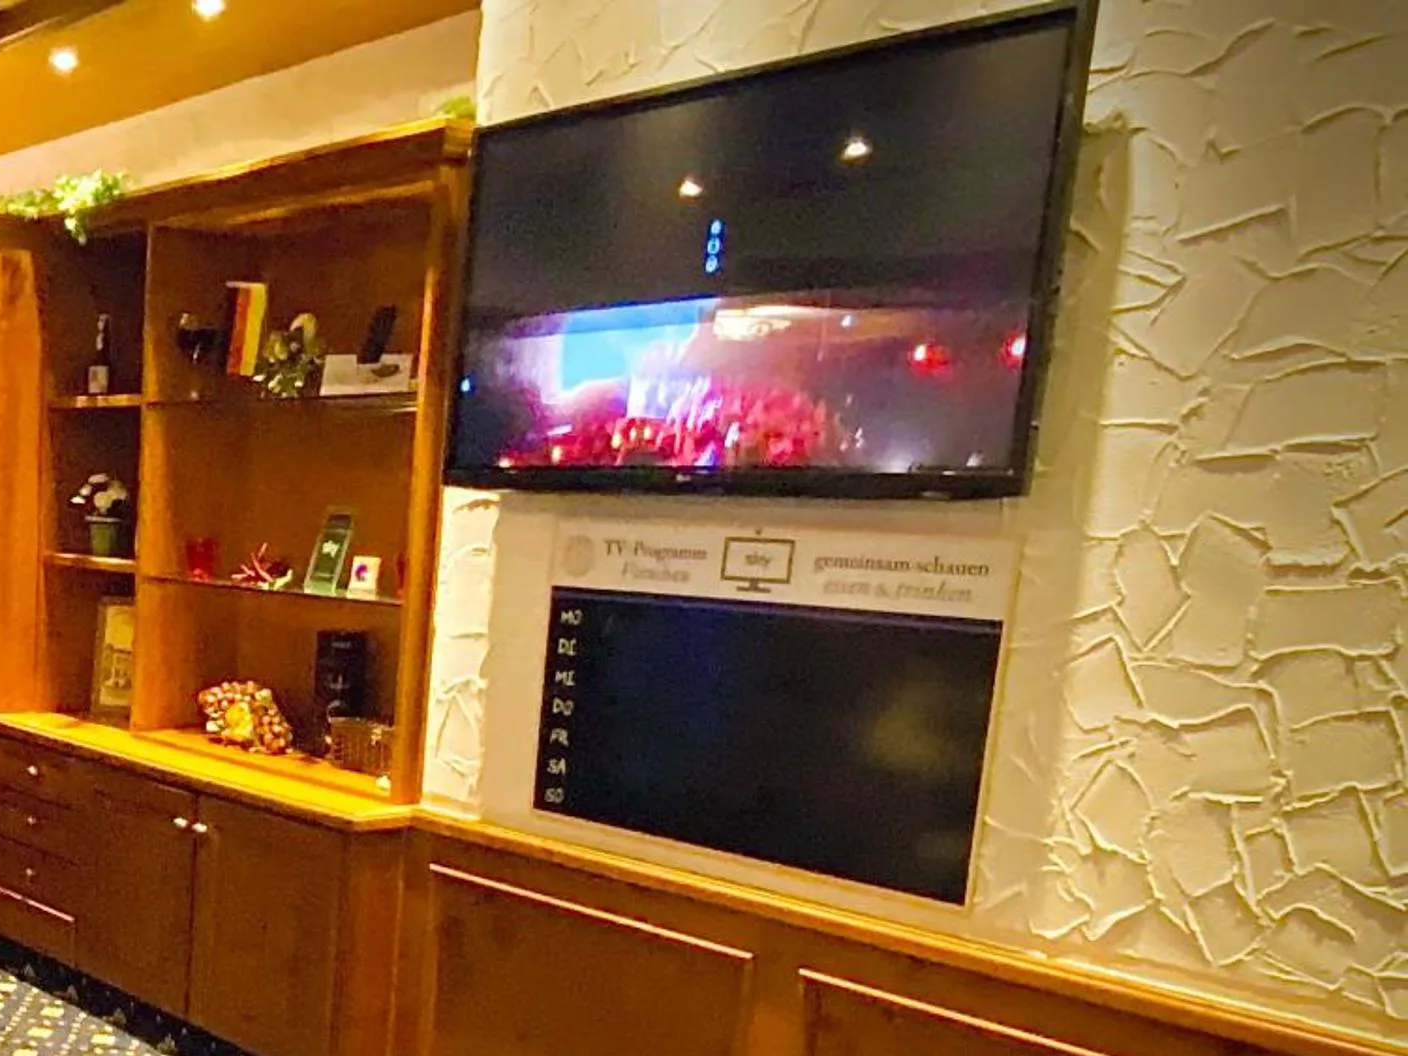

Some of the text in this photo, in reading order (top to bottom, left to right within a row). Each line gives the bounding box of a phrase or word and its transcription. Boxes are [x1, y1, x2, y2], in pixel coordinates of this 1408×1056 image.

[604, 539, 626, 557] TV
[814, 555, 990, 577] gemeinsam schauen
